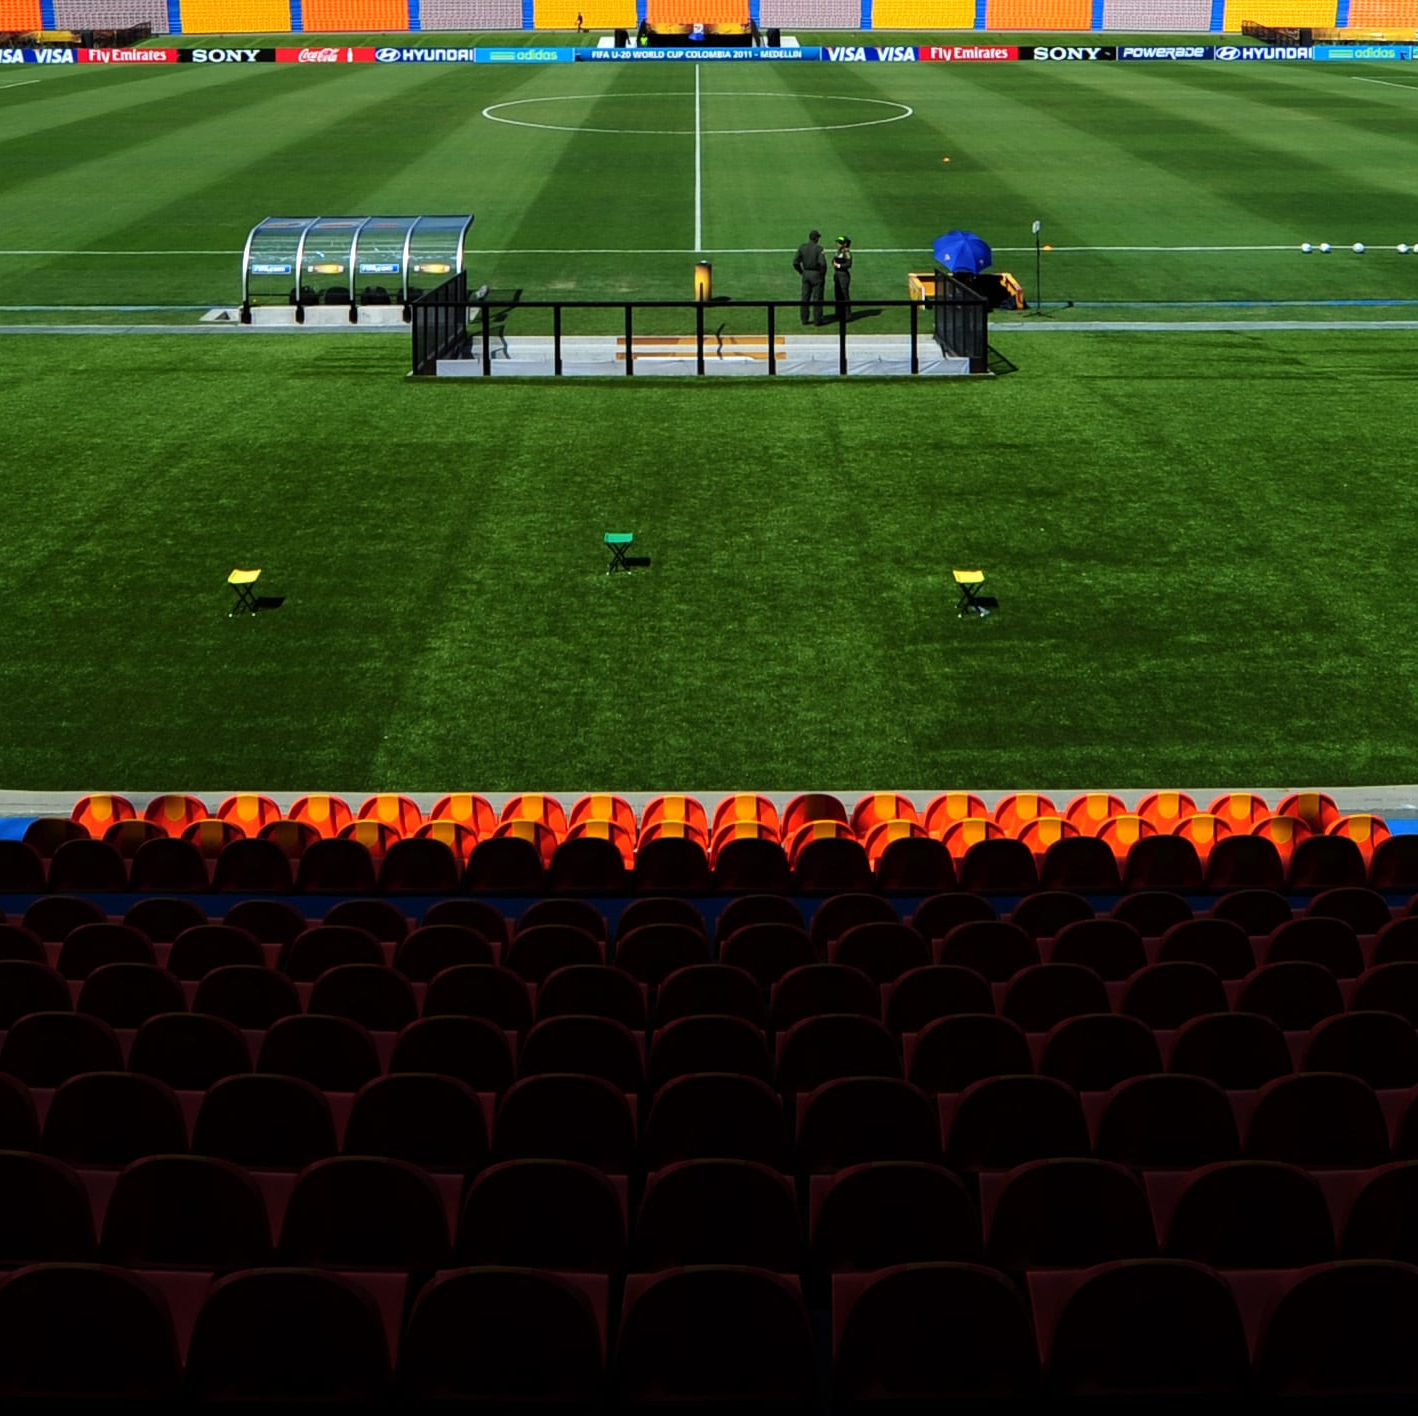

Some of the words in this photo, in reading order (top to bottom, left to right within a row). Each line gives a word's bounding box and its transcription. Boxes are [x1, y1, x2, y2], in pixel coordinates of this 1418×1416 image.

[33, 49, 74, 64] VISA
[88, 49, 110, 63] Fly
[112, 49, 166, 62] Emirates
[192, 49, 260, 63] SONY
[403, 49, 473, 61] HYUNDAI
[517, 49, 558, 60] adidas
[591, 50, 610, 59] FIFA
[611, 50, 630, 59] U-20
[632, 50, 664, 59] WORLD
[666, 50, 683, 59] CUP
[685, 50, 731, 59] COLOMBIA
[732, 50, 752, 59] 2011
[826, 47, 867, 62] VISA
[875, 47, 916, 62] VISA
[930, 47, 952, 61] Fly
[954, 47, 1008, 60] Emirates
[1033, 47, 1101, 61] SONY
[1242, 47, 1312, 59] HYUNDAI
[1354, 47, 1396, 59] adidas
